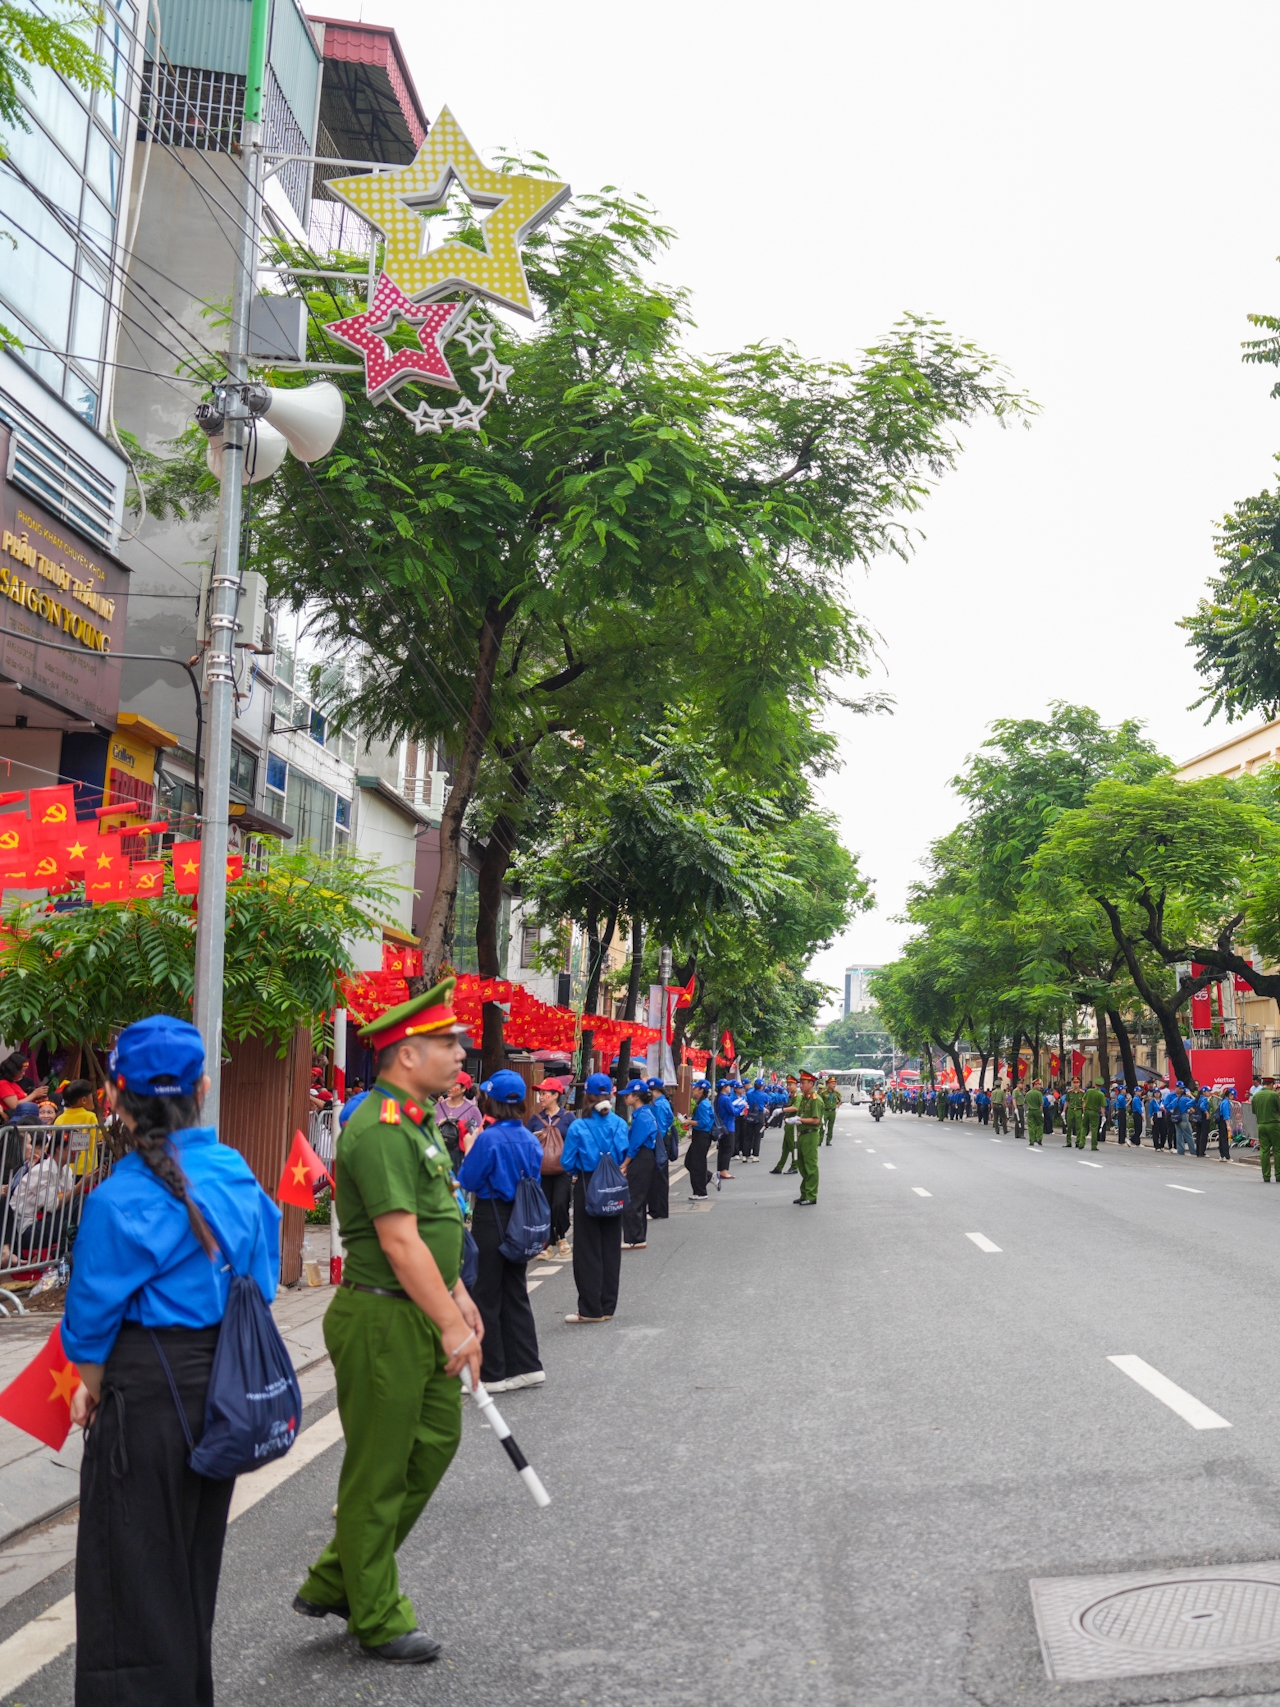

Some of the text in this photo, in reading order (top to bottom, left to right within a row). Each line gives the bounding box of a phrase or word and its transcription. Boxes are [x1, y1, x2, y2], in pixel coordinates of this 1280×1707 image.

[17, 510, 42, 535] PHÒNG
[89, 562, 106, 581] KHOA
[37, 553, 72, 593] THUẬT
[62, 606, 111, 658] YOUNG
[112, 744, 137, 768] Gallery
